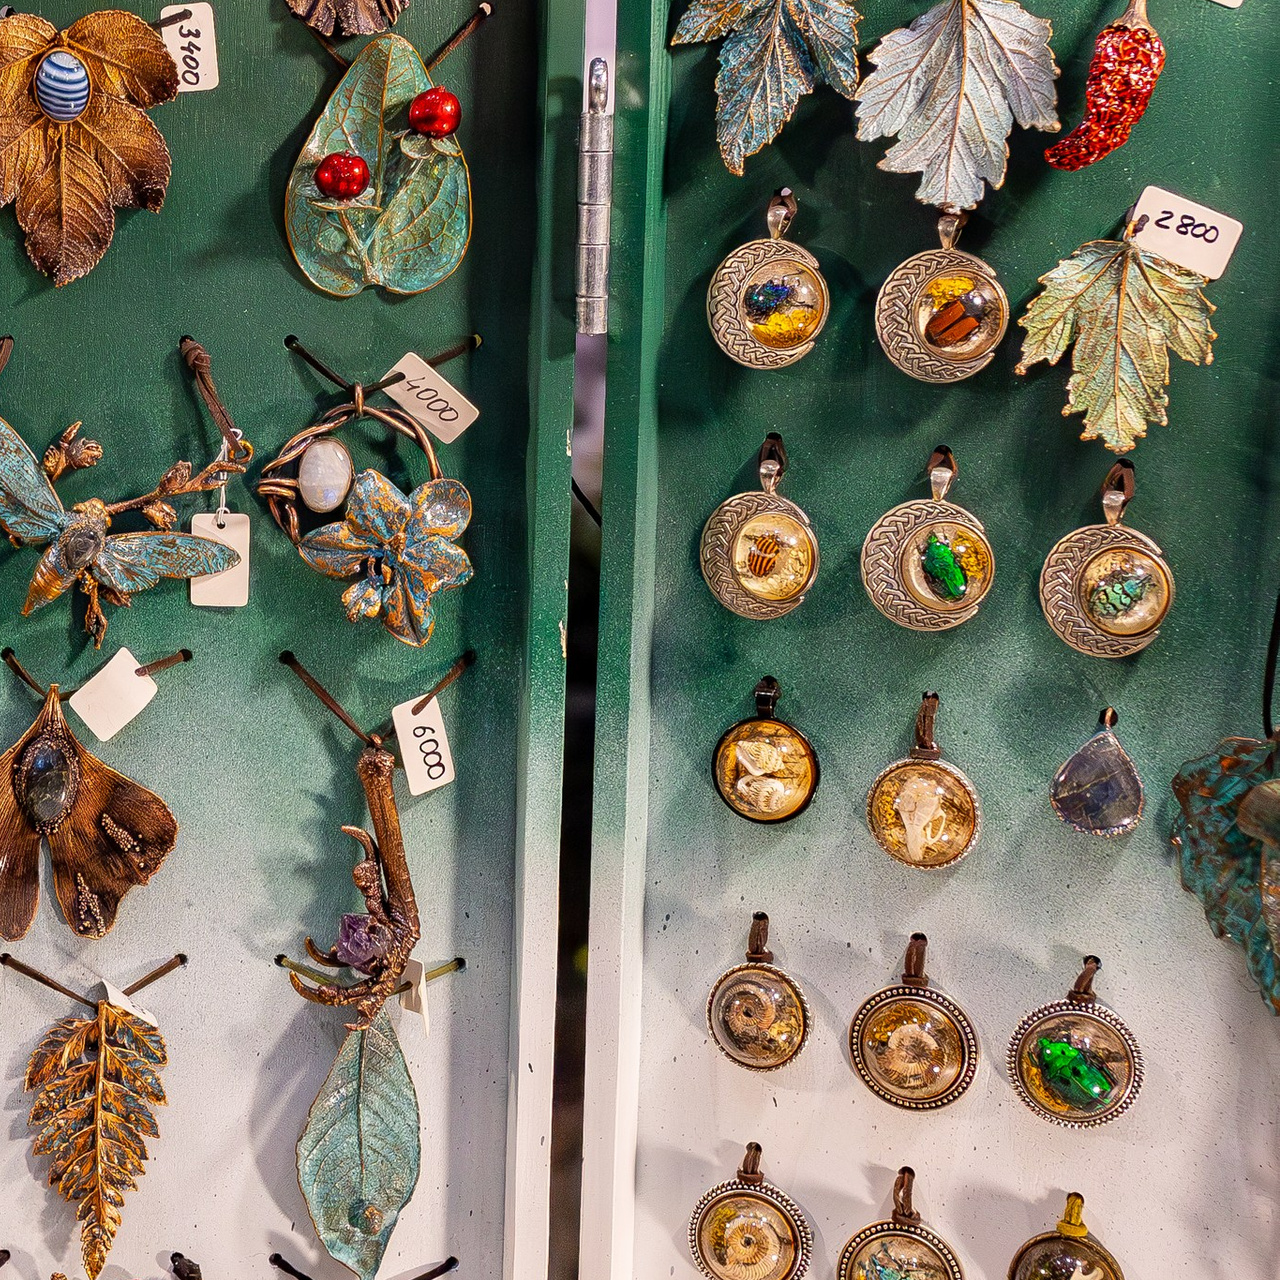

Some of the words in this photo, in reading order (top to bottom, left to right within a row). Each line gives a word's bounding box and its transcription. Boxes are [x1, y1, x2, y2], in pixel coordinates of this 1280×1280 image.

[178, 25, 201, 85] 3400
[1155, 210, 1219, 243] 2800
[406, 376, 459, 421] 4000
[413, 726, 445, 780] 6000
